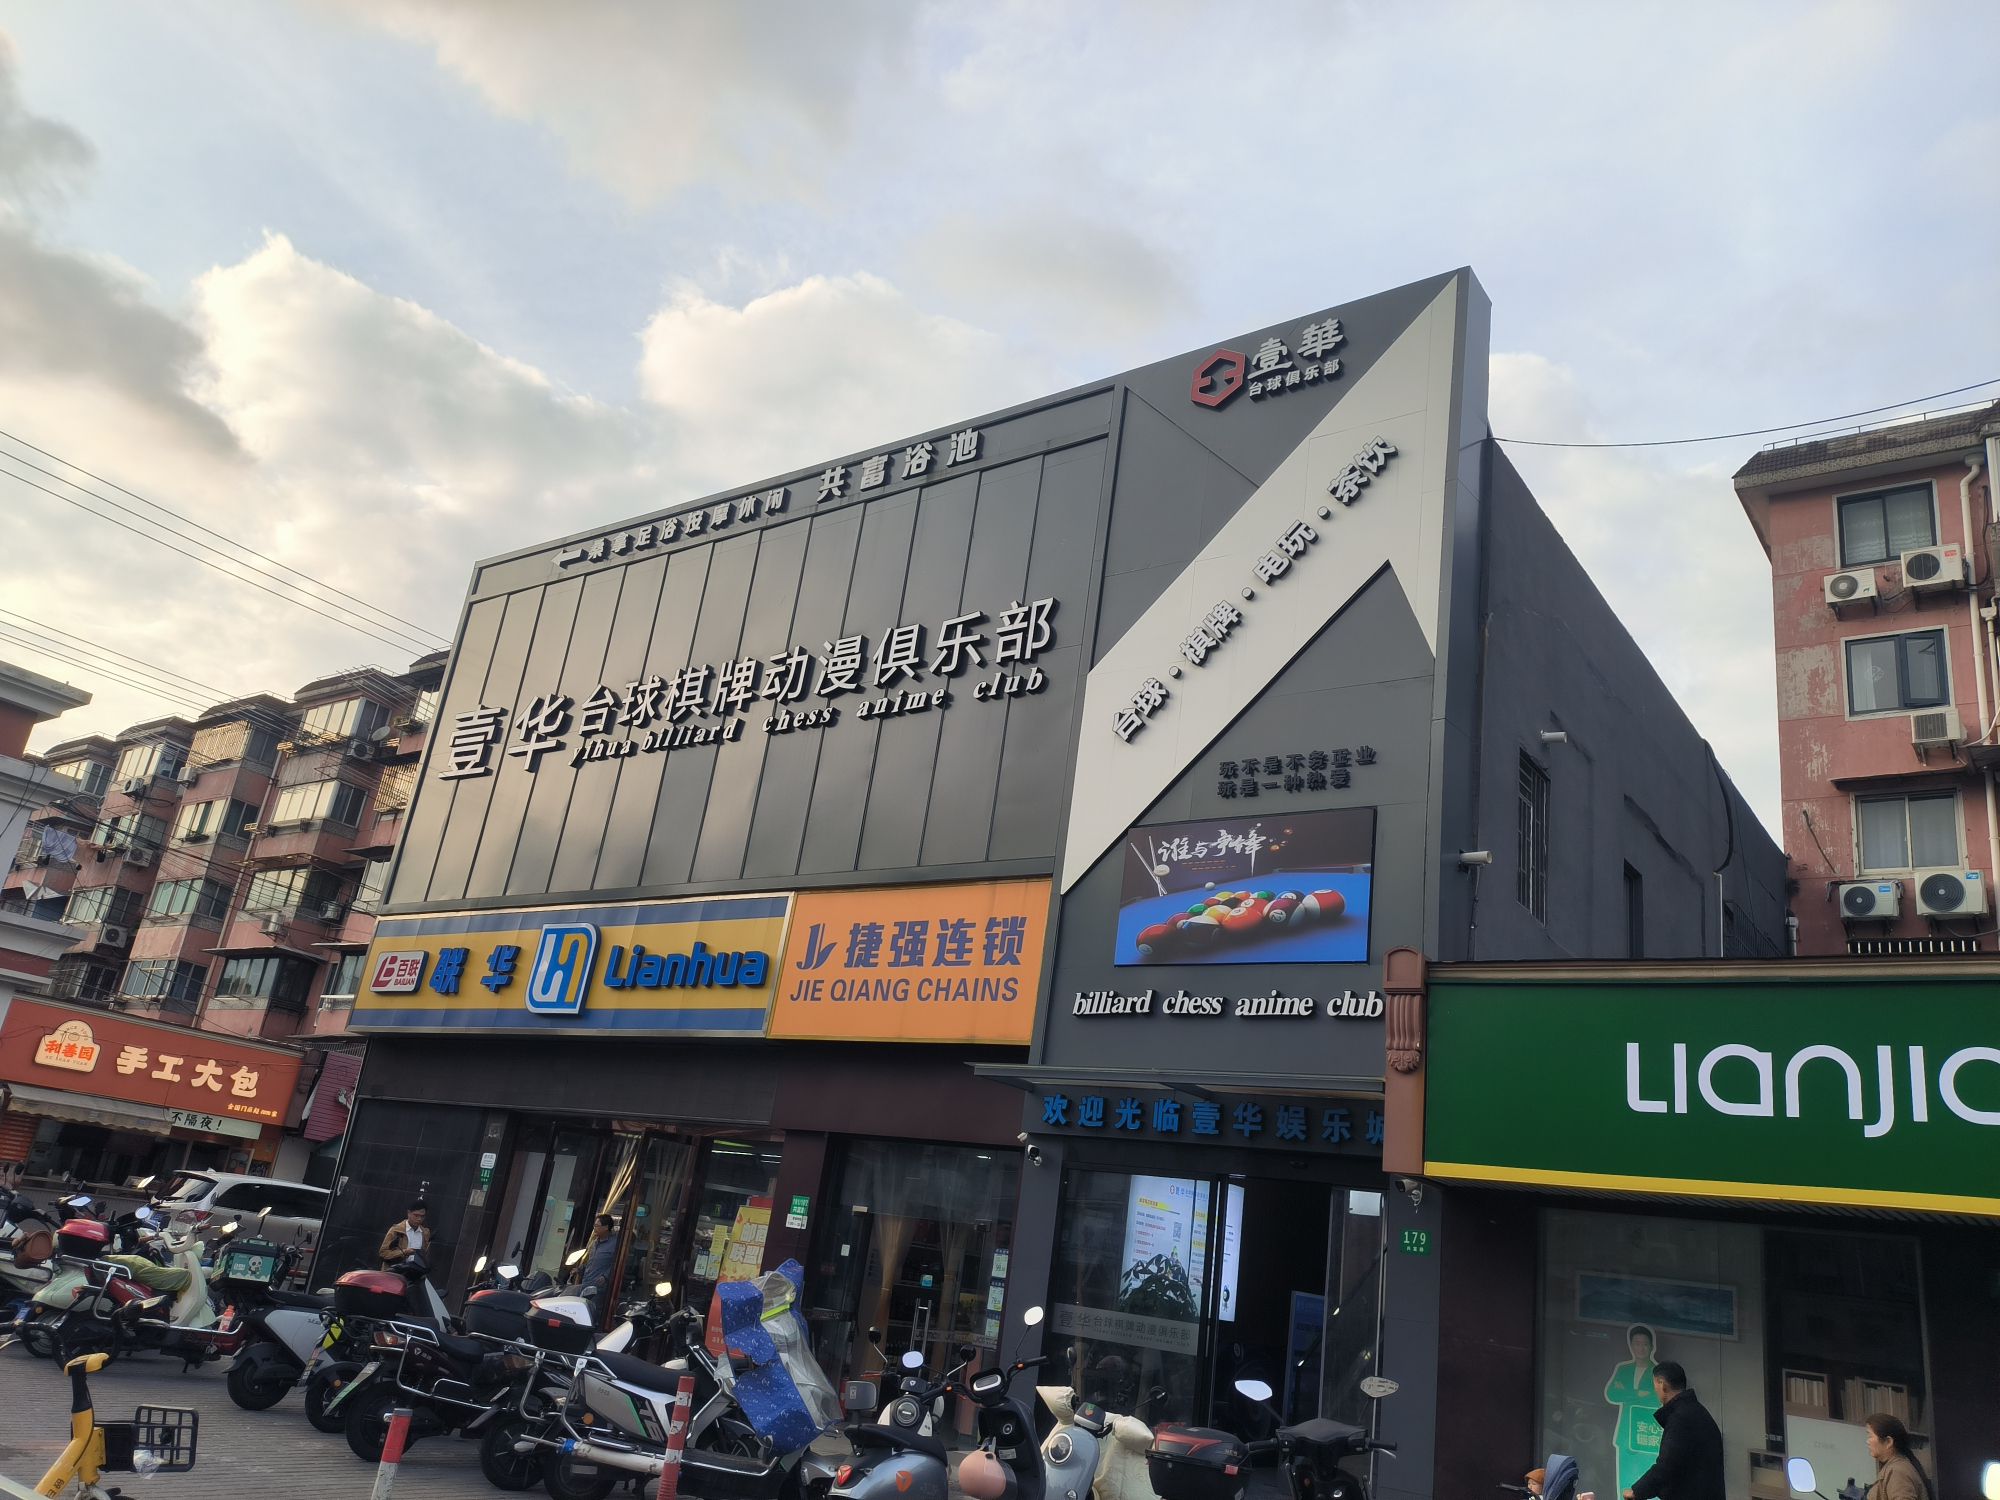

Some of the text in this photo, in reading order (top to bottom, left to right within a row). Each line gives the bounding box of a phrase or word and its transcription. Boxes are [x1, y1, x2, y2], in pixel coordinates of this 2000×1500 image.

[1249, 359, 1340, 397] 台球俱乐部
[587, 428, 979, 562] 桑拿足浴按摩休闲 共富浴池
[568, 667, 1045, 767] yihua billiard chess anime club
[1219, 745, 1377, 780] 玩不是不务正业
[1216, 768, 1351, 800] 玩是一种热爱
[1157, 829, 1266, 876] 谁与争锋
[844, 916, 1027, 968] 捷强连锁
[397, 958, 420, 977] 百联
[429, 945, 521, 994] 联华
[604, 942, 769, 988] Lianhua
[790, 977, 1019, 1003] JIE QIANG CHAINS
[1072, 989, 1383, 1017] billiard chess anime club
[116, 1045, 259, 1098] 手工大包
[1403, 1231, 1426, 1245] 179
